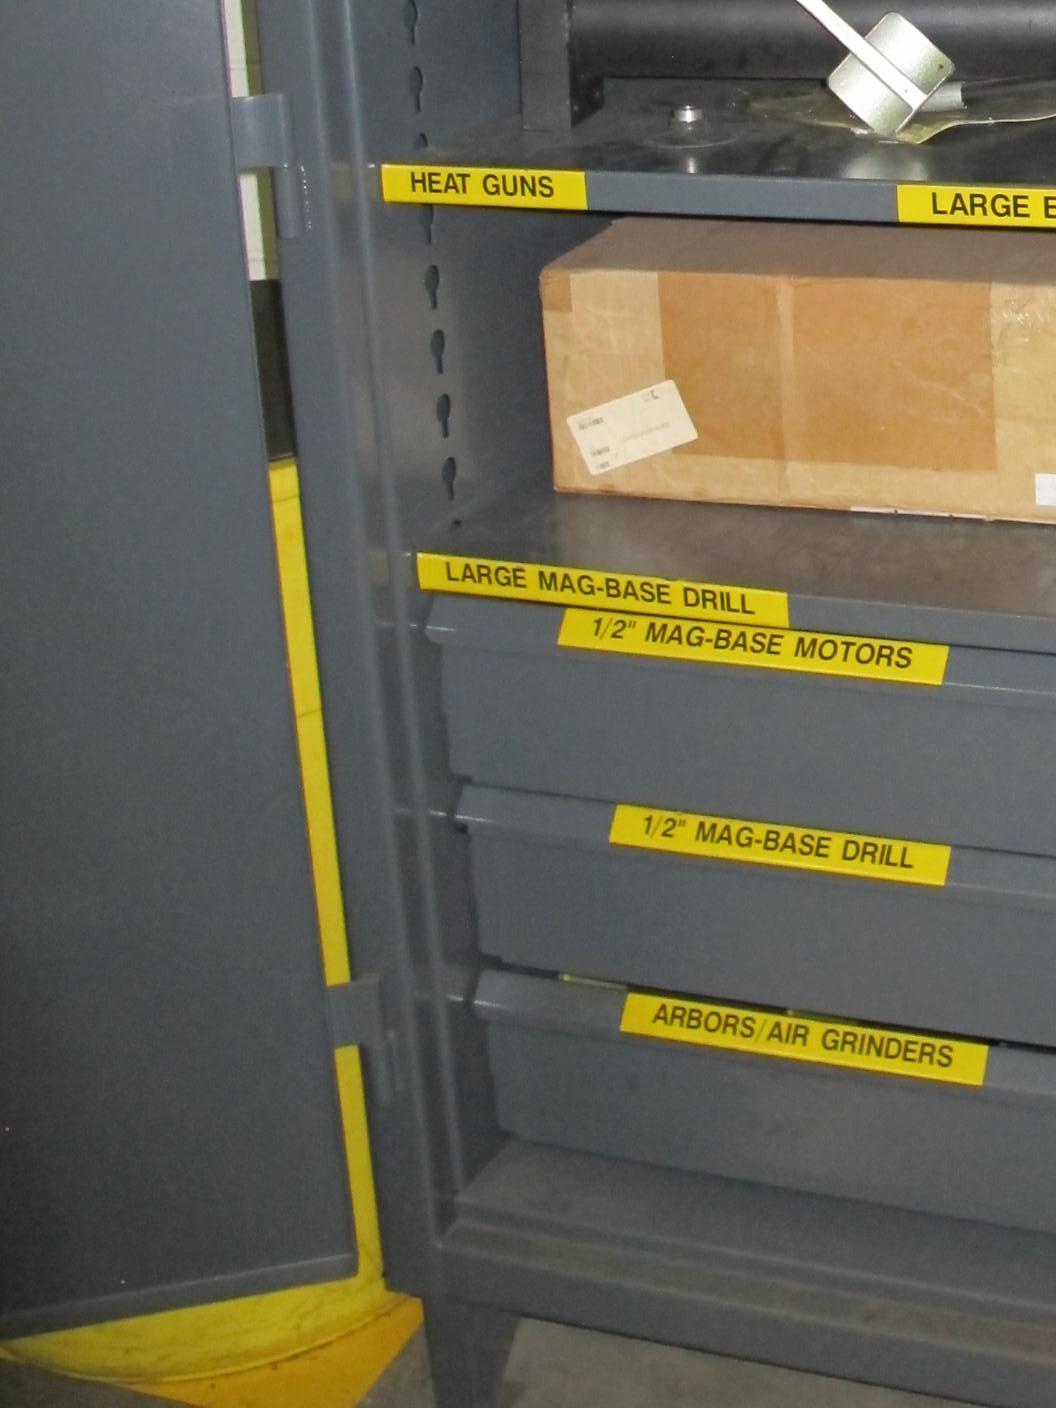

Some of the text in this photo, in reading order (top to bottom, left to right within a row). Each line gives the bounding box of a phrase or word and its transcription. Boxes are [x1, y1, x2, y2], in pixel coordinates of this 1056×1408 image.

[411, 172, 554, 198] HEAT GUNS
[931, 192, 1030, 218] LARGE
[445, 561, 756, 615] LARGE MAG-BASE DRILL
[592, 618, 913, 669] 1/2" MAG-BASE MOTORS
[643, 815, 914, 869] 1/2" MAG-BASE DRILL
[652, 1003, 954, 1068] ARBORS/AIR GRINDERS
